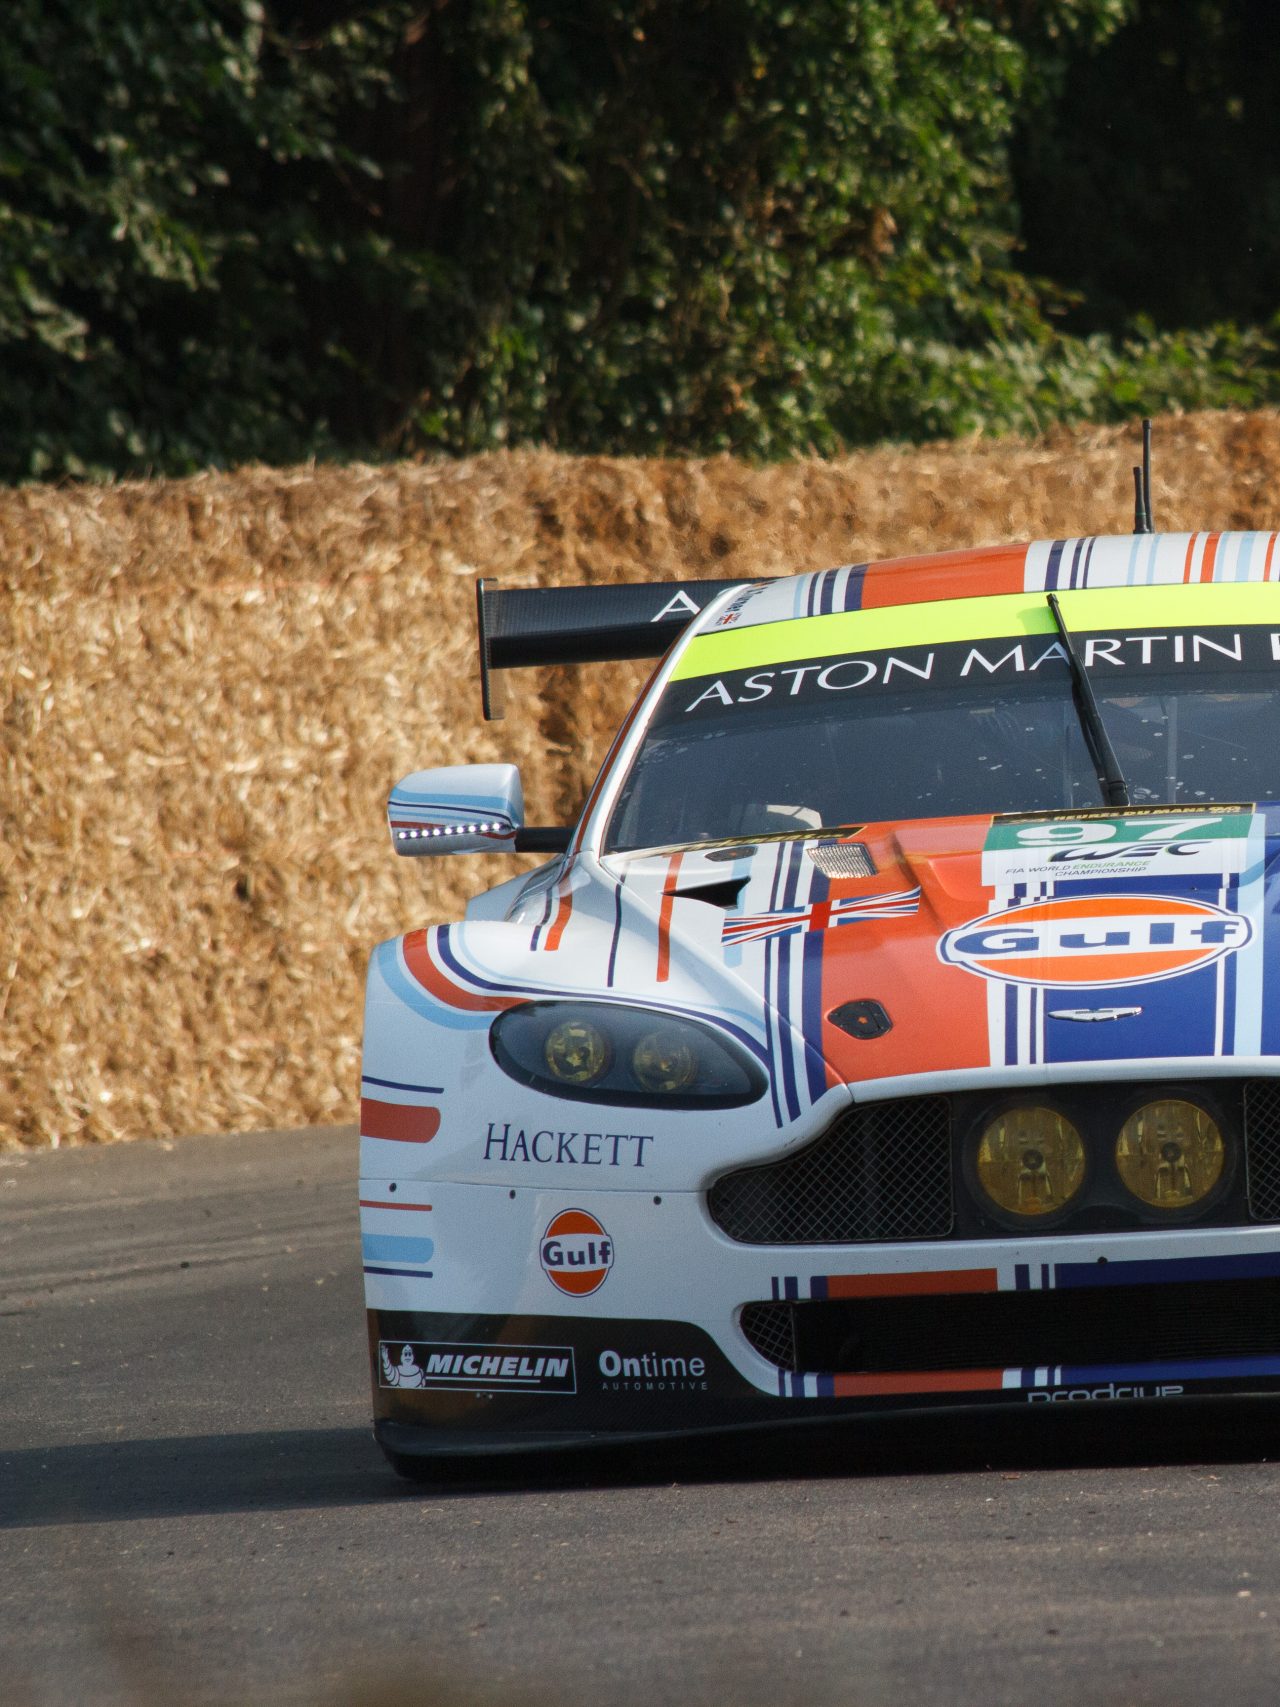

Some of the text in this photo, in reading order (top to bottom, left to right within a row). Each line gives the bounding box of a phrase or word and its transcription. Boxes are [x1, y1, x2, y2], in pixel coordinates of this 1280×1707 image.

[685, 652, 935, 713] ASTON
[959, 632, 1243, 677] MARTIN
[1016, 817, 1223, 847] 97
[1046, 841, 1213, 863] WEC
[1005, 860, 1151, 875] FIA WORLD ENDURANCE
[1055, 866, 1148, 877] CHAMPIONSHIP
[952, 919, 1240, 957] Gulf
[483, 1122, 654, 1168] HACKETT
[541, 1240, 613, 1267] Gulf
[425, 1354, 570, 1379] MICHELIN
[599, 1349, 706, 1378] Ontime
[601, 1382, 709, 1391] AUTOMOTIVE
